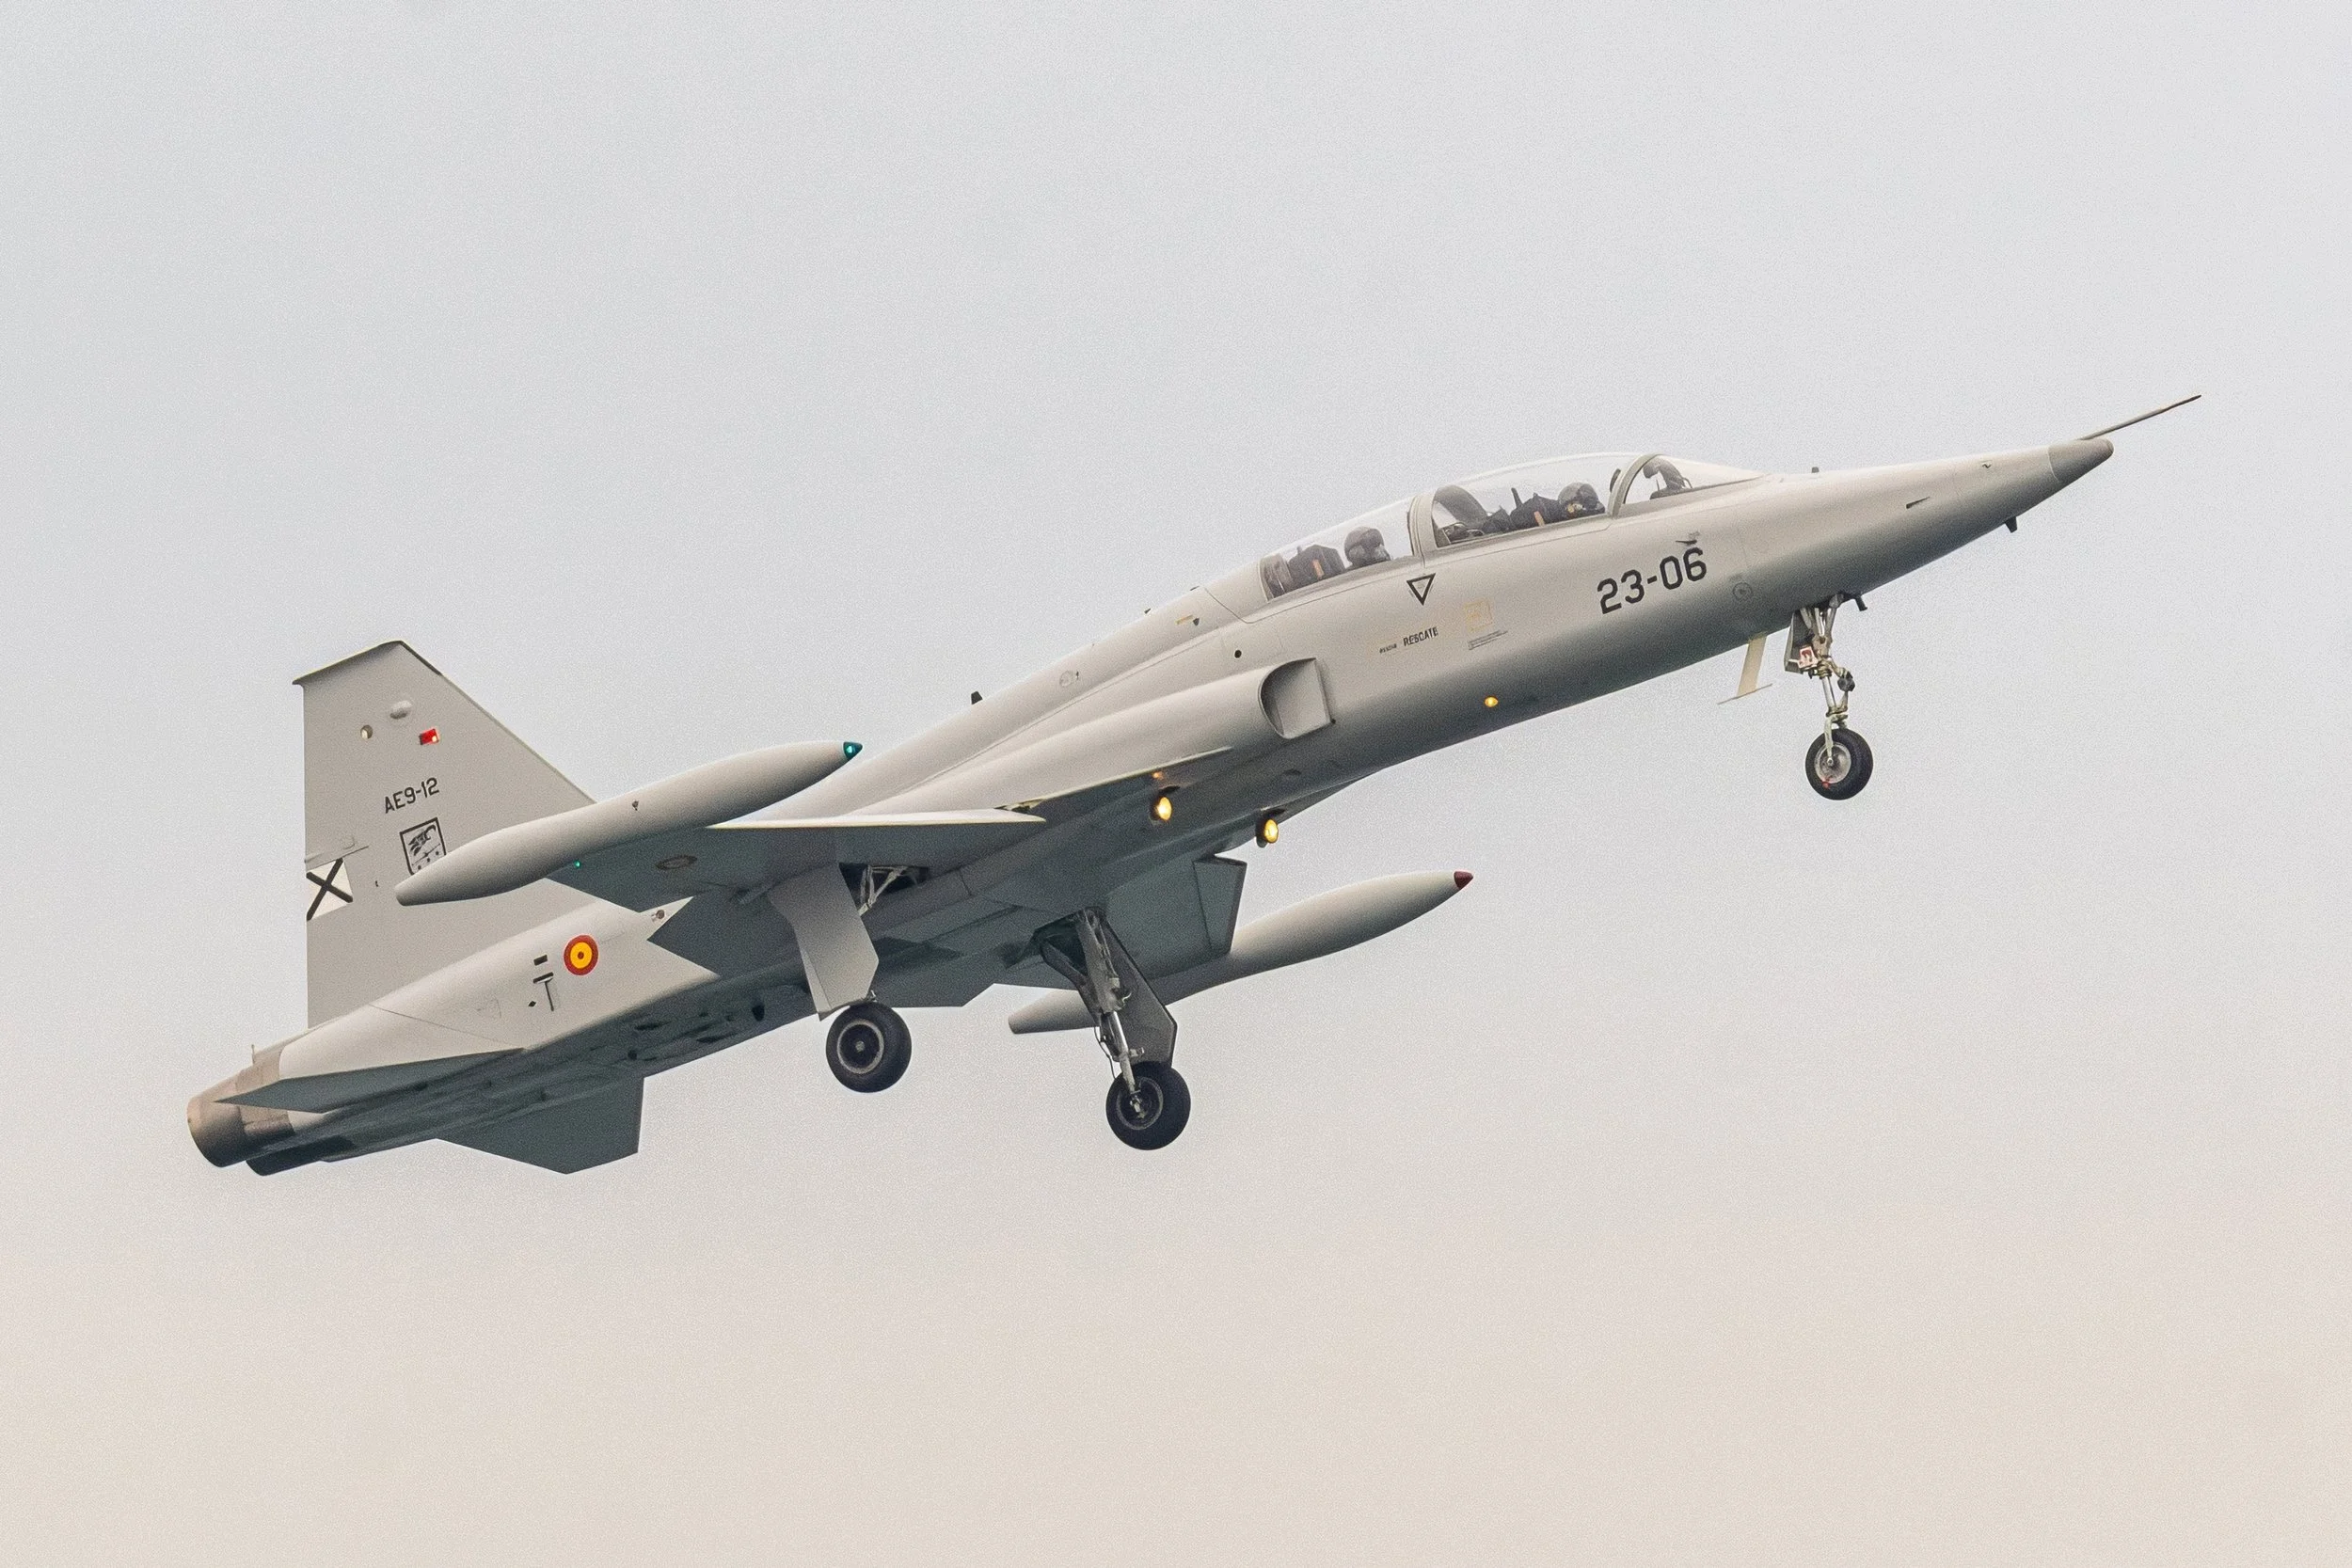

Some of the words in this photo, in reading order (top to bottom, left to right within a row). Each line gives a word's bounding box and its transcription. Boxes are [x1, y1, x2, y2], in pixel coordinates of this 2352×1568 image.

[1597, 546, 1708, 614] 23-06
[1403, 626, 1438, 646] RESCATE
[385, 777, 439, 814] AE9-12
